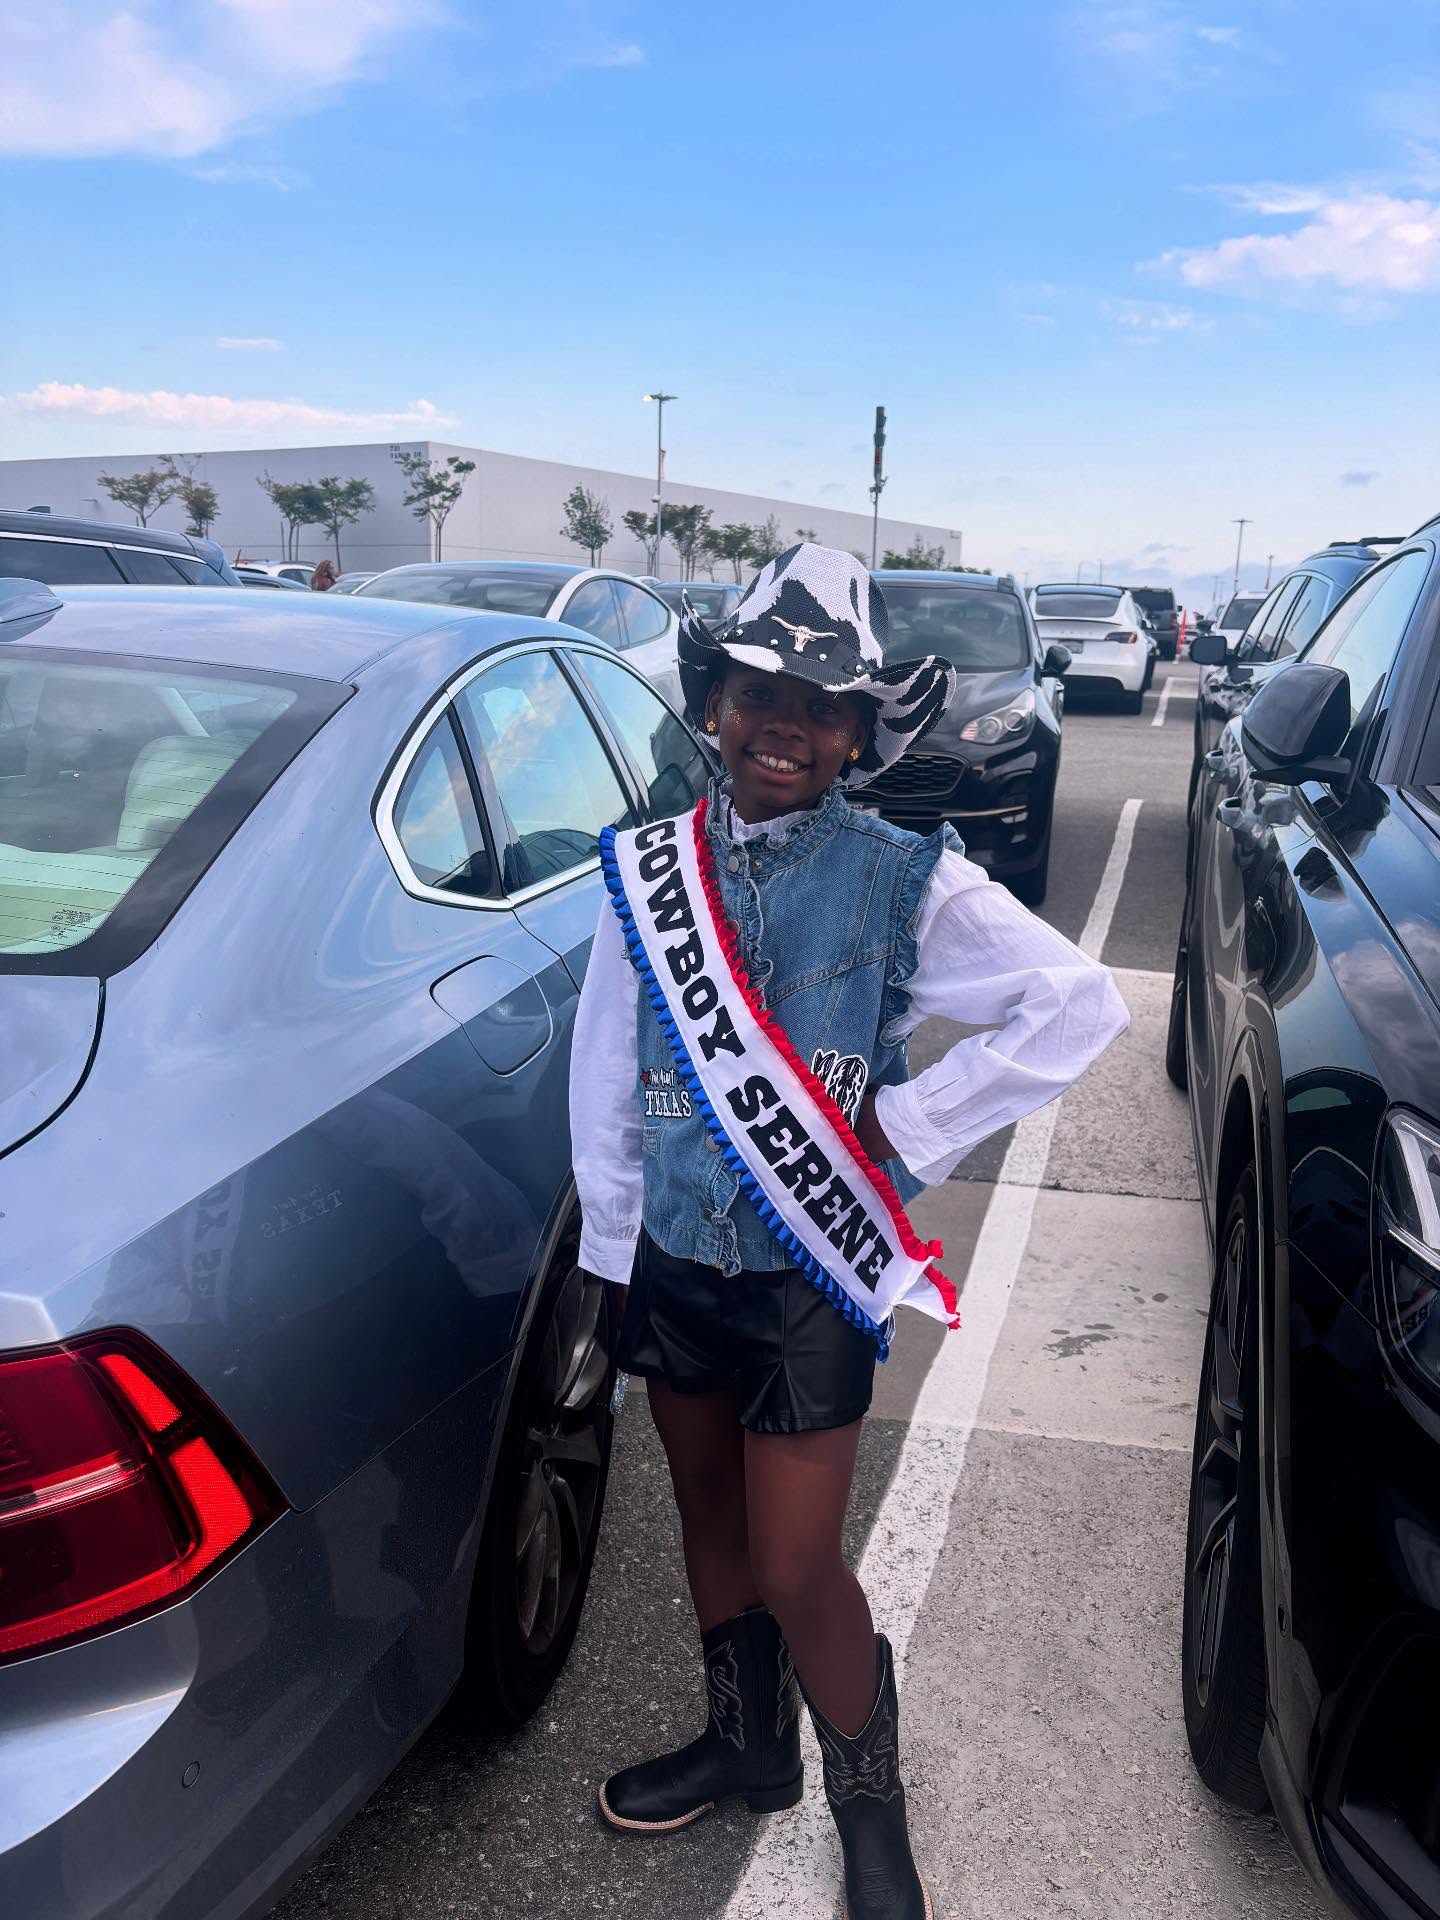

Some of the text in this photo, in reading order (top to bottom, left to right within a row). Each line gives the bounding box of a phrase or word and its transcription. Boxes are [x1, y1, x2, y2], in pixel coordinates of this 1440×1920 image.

[634, 820, 894, 1294] COWBOY SERENE
[645, 1090, 691, 1117] TEXAS
